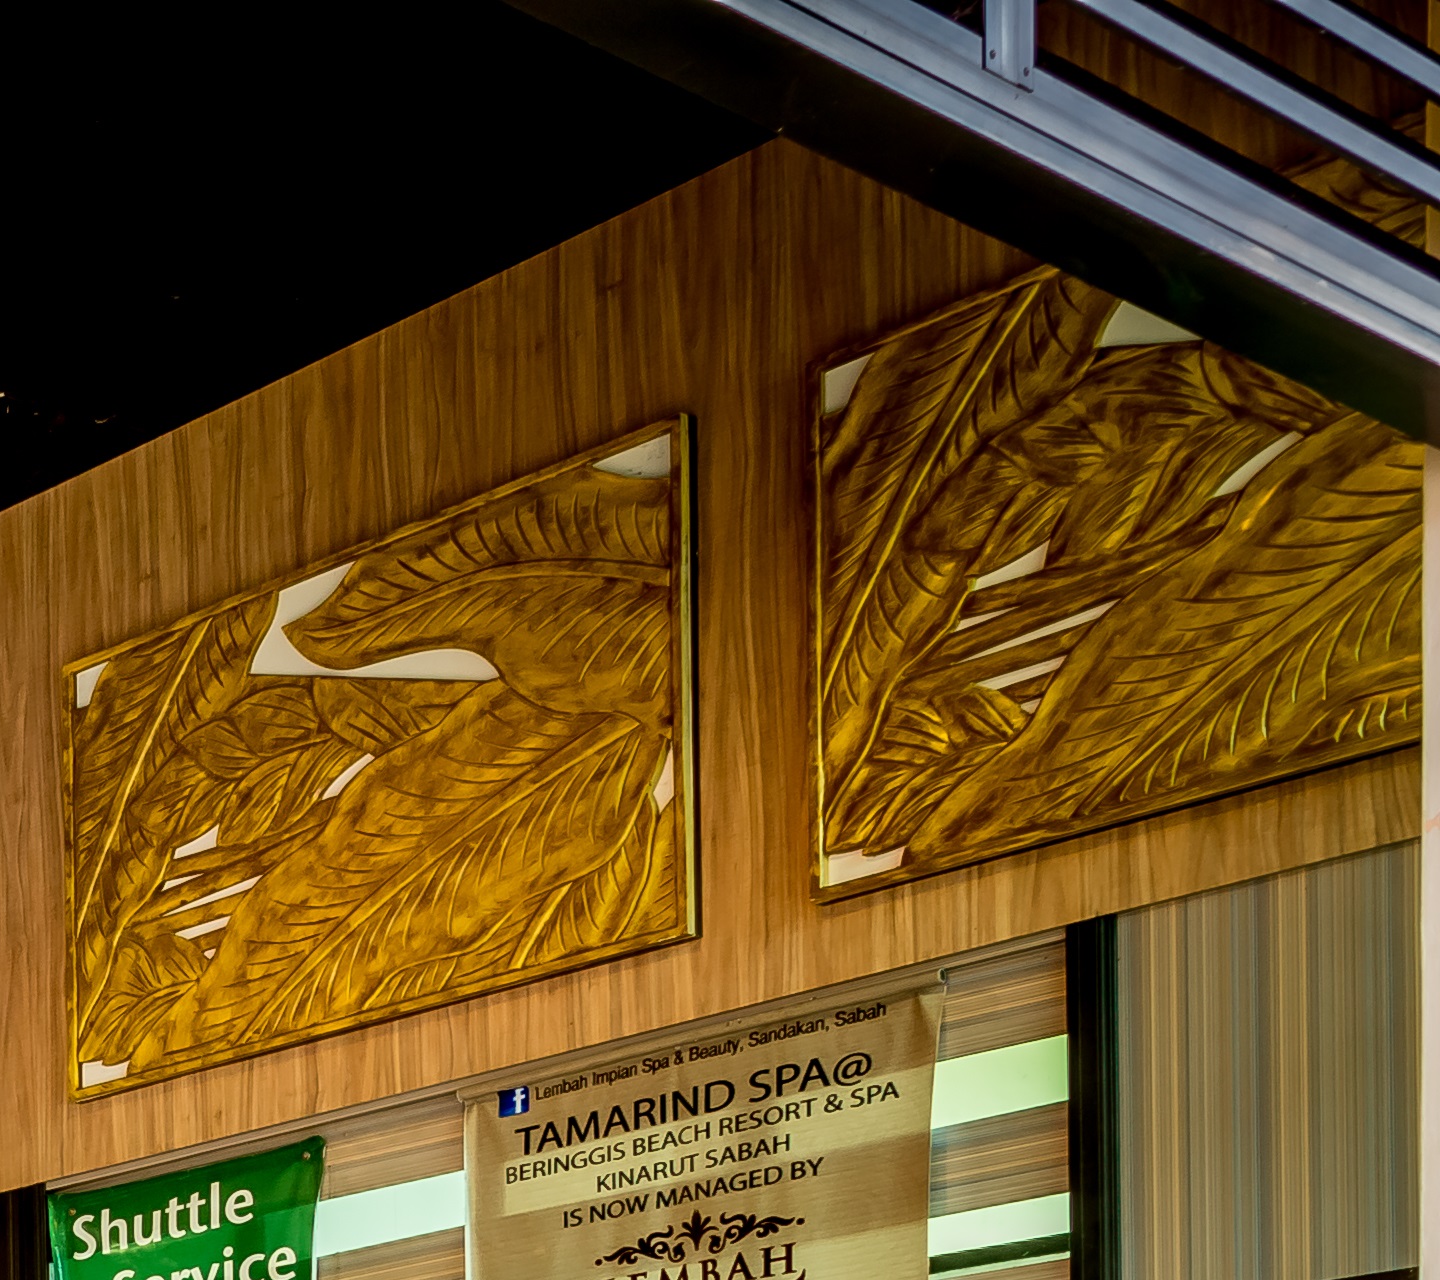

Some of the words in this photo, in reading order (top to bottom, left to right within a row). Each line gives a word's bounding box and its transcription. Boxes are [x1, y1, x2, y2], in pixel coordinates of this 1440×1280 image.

[535, 1075, 588, 1100] Lembah
[592, 1064, 637, 1086] Impian
[642, 1053, 669, 1076] Spa
[674, 1050, 683, 1065] &
[688, 1038, 744, 1062] Beauty,
[748, 1018, 830, 1048] Sandakan,
[834, 1002, 887, 1027] Sabah
[506, 1142, 625, 1184] BERINGGIS
[632, 1121, 711, 1156] BEACH
[718, 1098, 818, 1136] RESORT
[823, 1093, 844, 1113] &
[850, 1081, 900, 1108] SPA
[514, 1079, 736, 1156] TAMARIND
[748, 1052, 872, 1102] SPA@
[563, 1208, 582, 1228] IS
[590, 1193, 650, 1224] NOW
[656, 1166, 783, 1209] MANAGED
[790, 1156, 825, 1180] BY
[596, 1152, 699, 1193] KINARUT
[705, 1134, 791, 1169] SABAH
[72, 1181, 254, 1260] Shuttle
